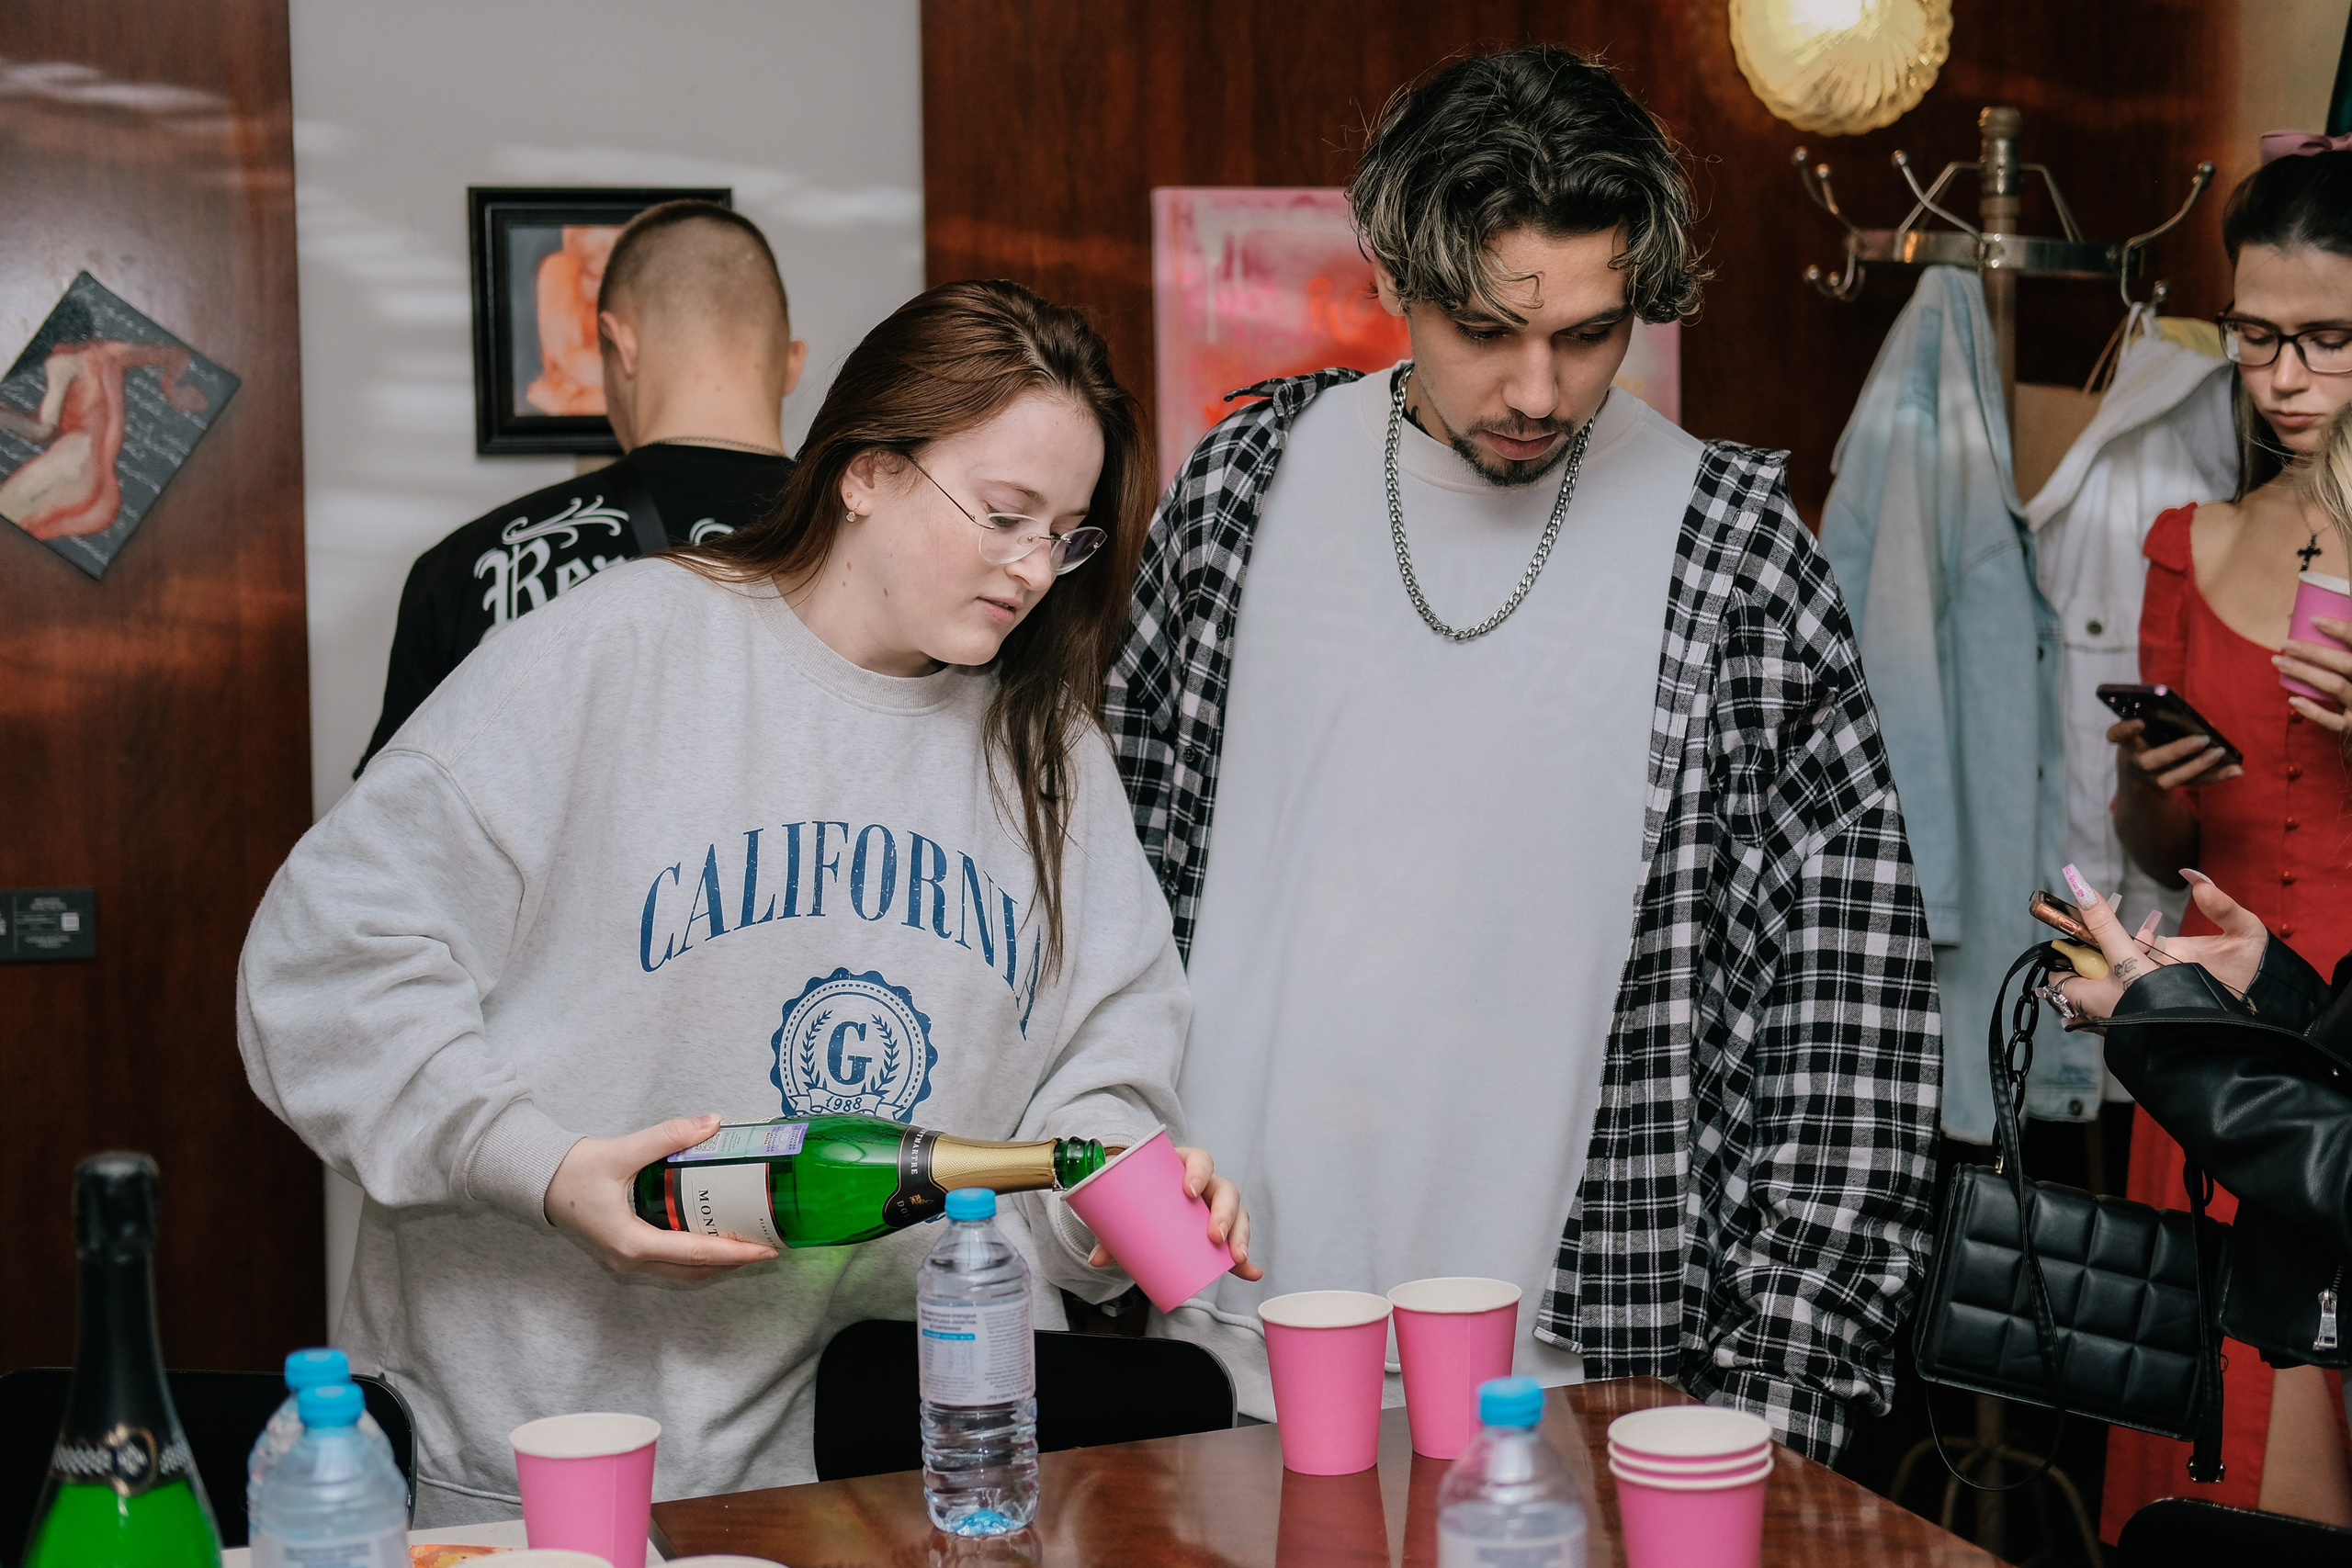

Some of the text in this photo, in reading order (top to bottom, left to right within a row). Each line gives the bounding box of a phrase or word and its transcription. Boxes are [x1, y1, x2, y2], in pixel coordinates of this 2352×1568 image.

[640, 820, 1041, 1041] CALIFORNIA
[828, 1021, 873, 1085] G
[826, 1095, 863, 1111] 1988
[910, 1128, 926, 1175] NTMARTRE
[698, 1189, 718, 1237] MONT
